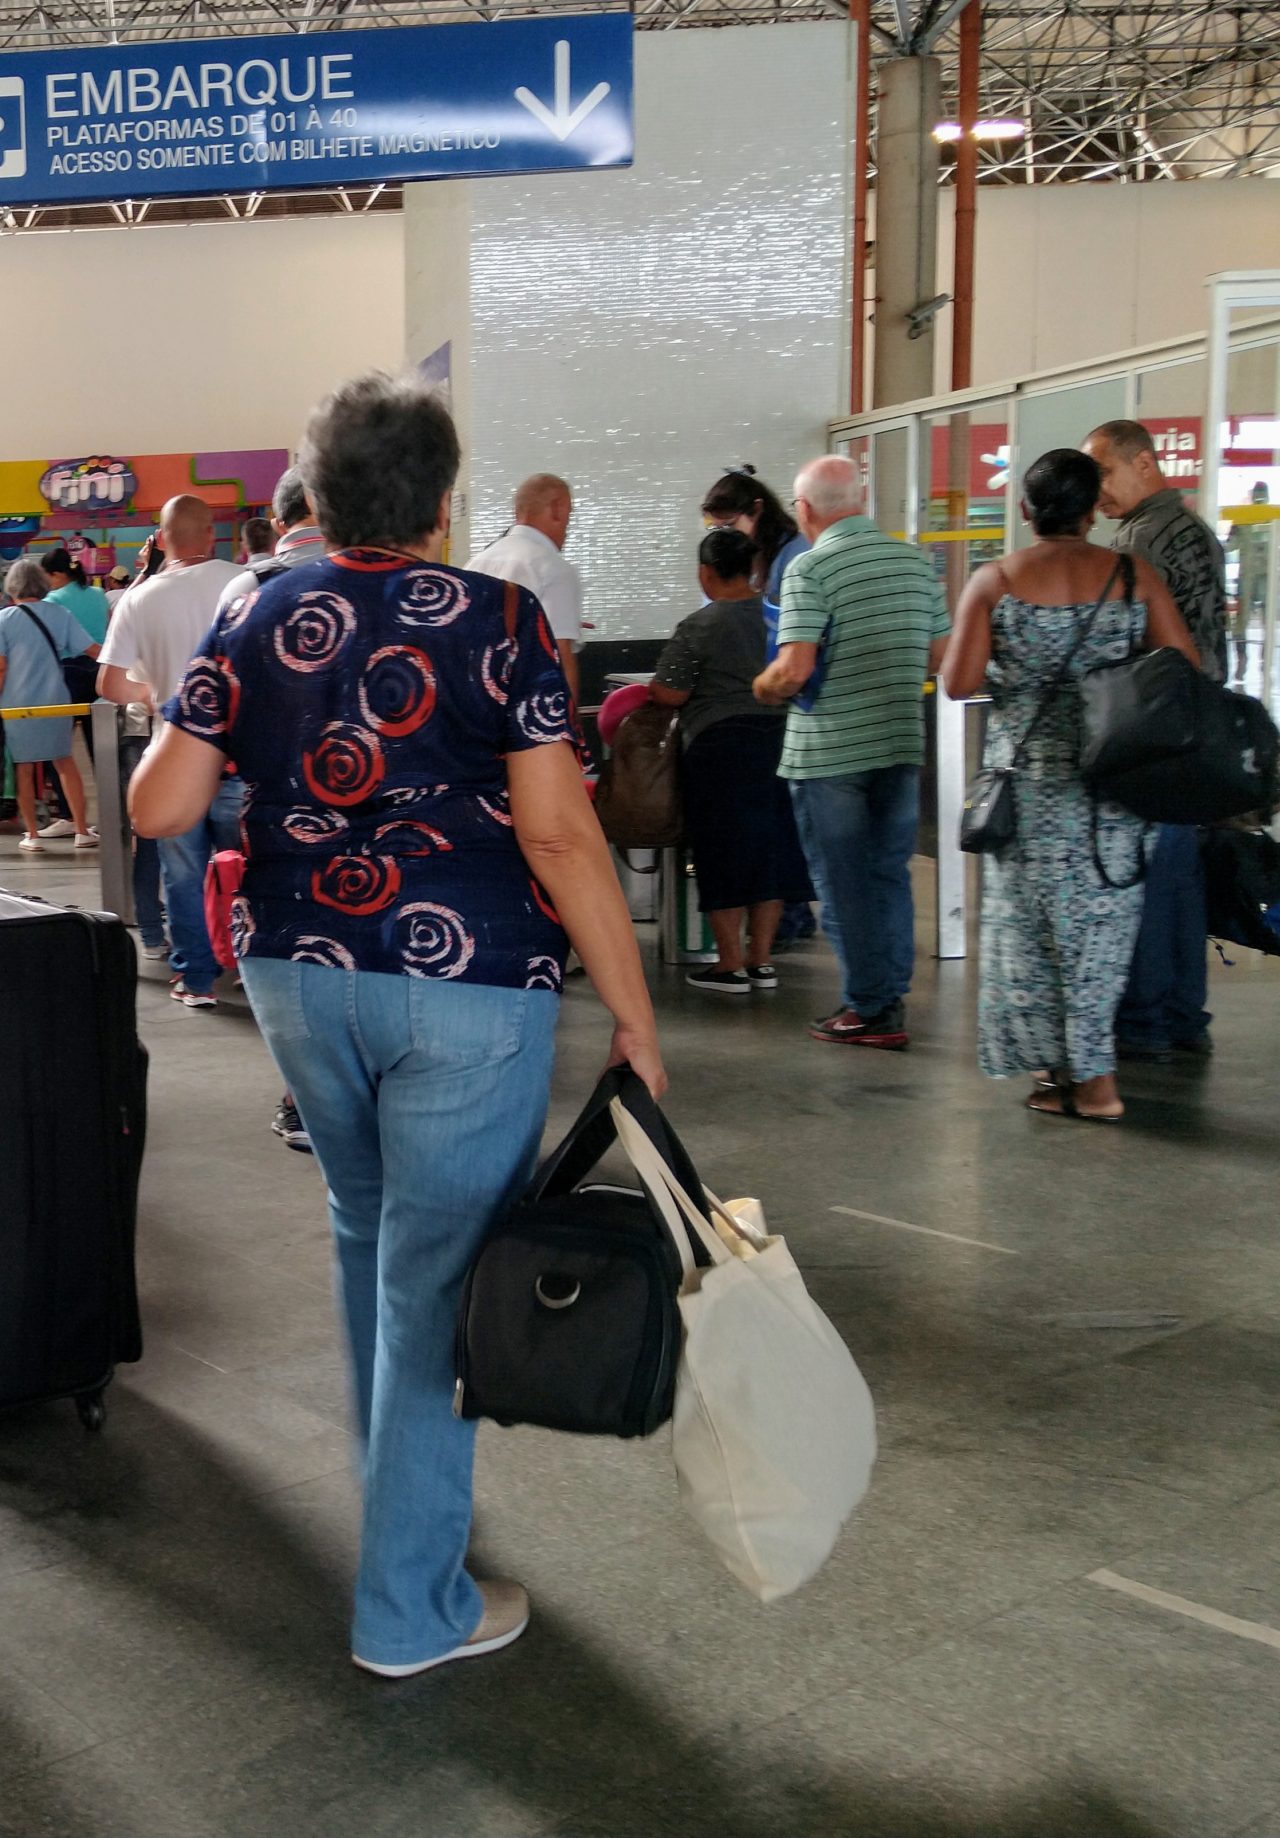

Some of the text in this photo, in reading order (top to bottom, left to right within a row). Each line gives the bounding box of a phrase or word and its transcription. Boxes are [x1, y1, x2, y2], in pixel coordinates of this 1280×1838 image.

[46, 54, 355, 118] EMBARQUE
[47, 104, 357, 148] PLATAFORMAS DE 01 À 40
[50, 149, 133, 175] ACESSO
[137, 143, 234, 170] SOMENTE
[239, 140, 286, 164] COM
[290, 135, 374, 161] BILHETE
